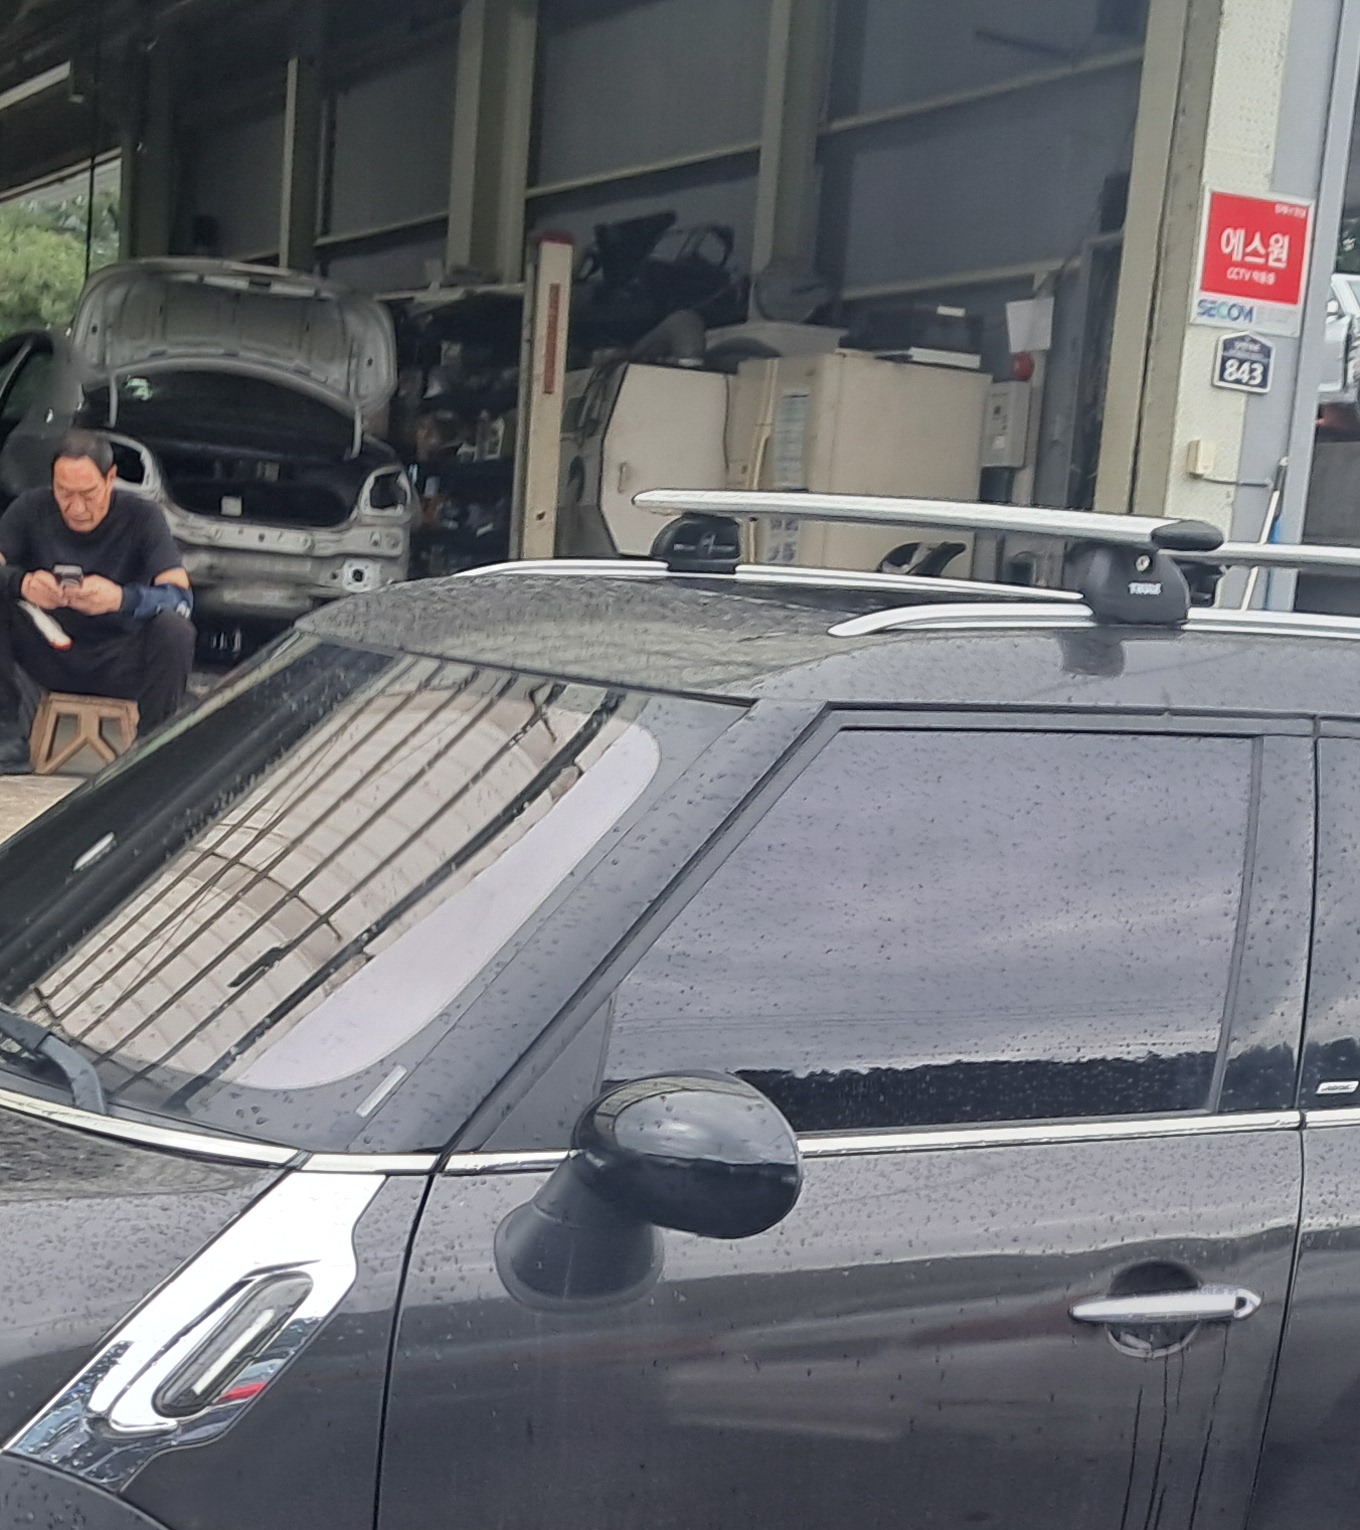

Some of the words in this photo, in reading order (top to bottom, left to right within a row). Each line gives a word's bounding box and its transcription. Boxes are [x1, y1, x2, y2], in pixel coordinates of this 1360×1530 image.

[1220, 227, 1290, 269] 에스원
[1226, 266, 1252, 281] CCTV
[1197, 299, 1254, 323] SECOM
[1223, 358, 1264, 385] 843
